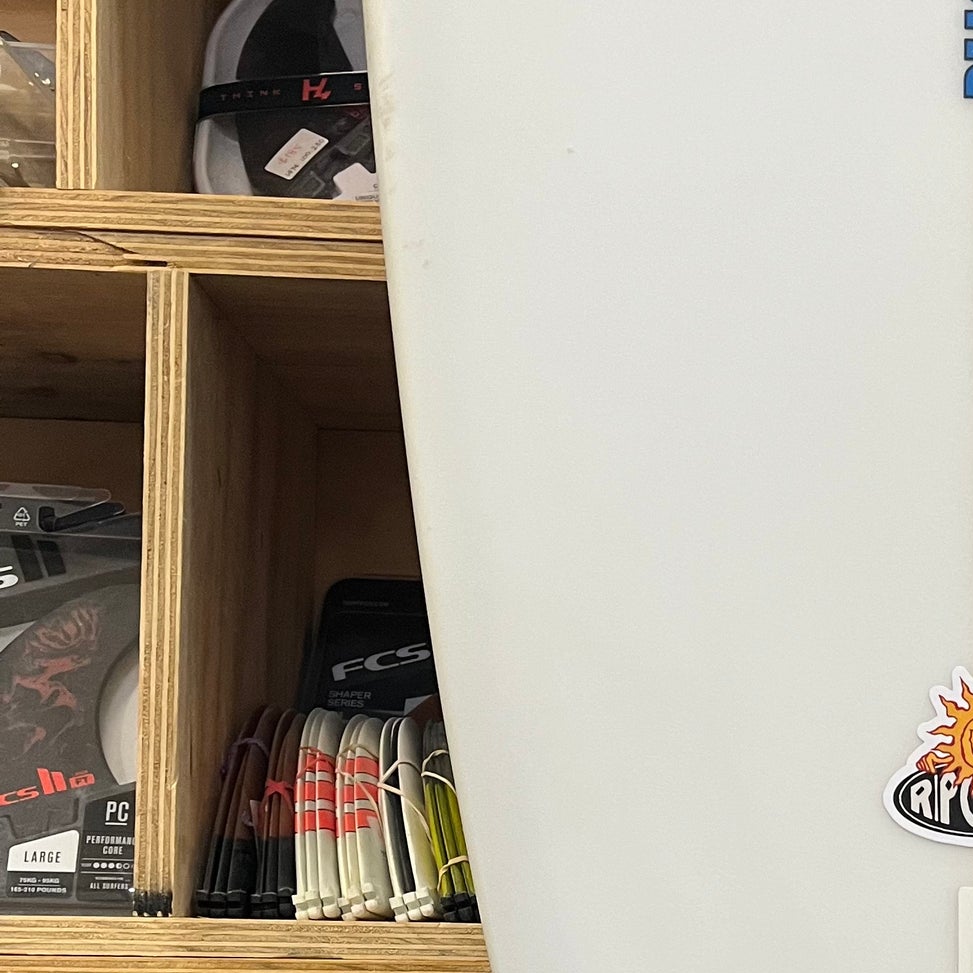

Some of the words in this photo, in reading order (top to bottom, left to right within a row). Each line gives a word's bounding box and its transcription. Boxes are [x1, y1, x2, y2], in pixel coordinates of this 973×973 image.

[220, 90, 281, 101] THINK
[332, 642, 431, 682] FCS
[328, 690, 371, 700] SHAPER
[327, 699, 365, 708] SERIES
[910, 771, 958, 826] RIP
[105, 801, 130, 822] PC
[102, 846, 123, 855] CORE
[24, 851, 62, 863] LARGE
